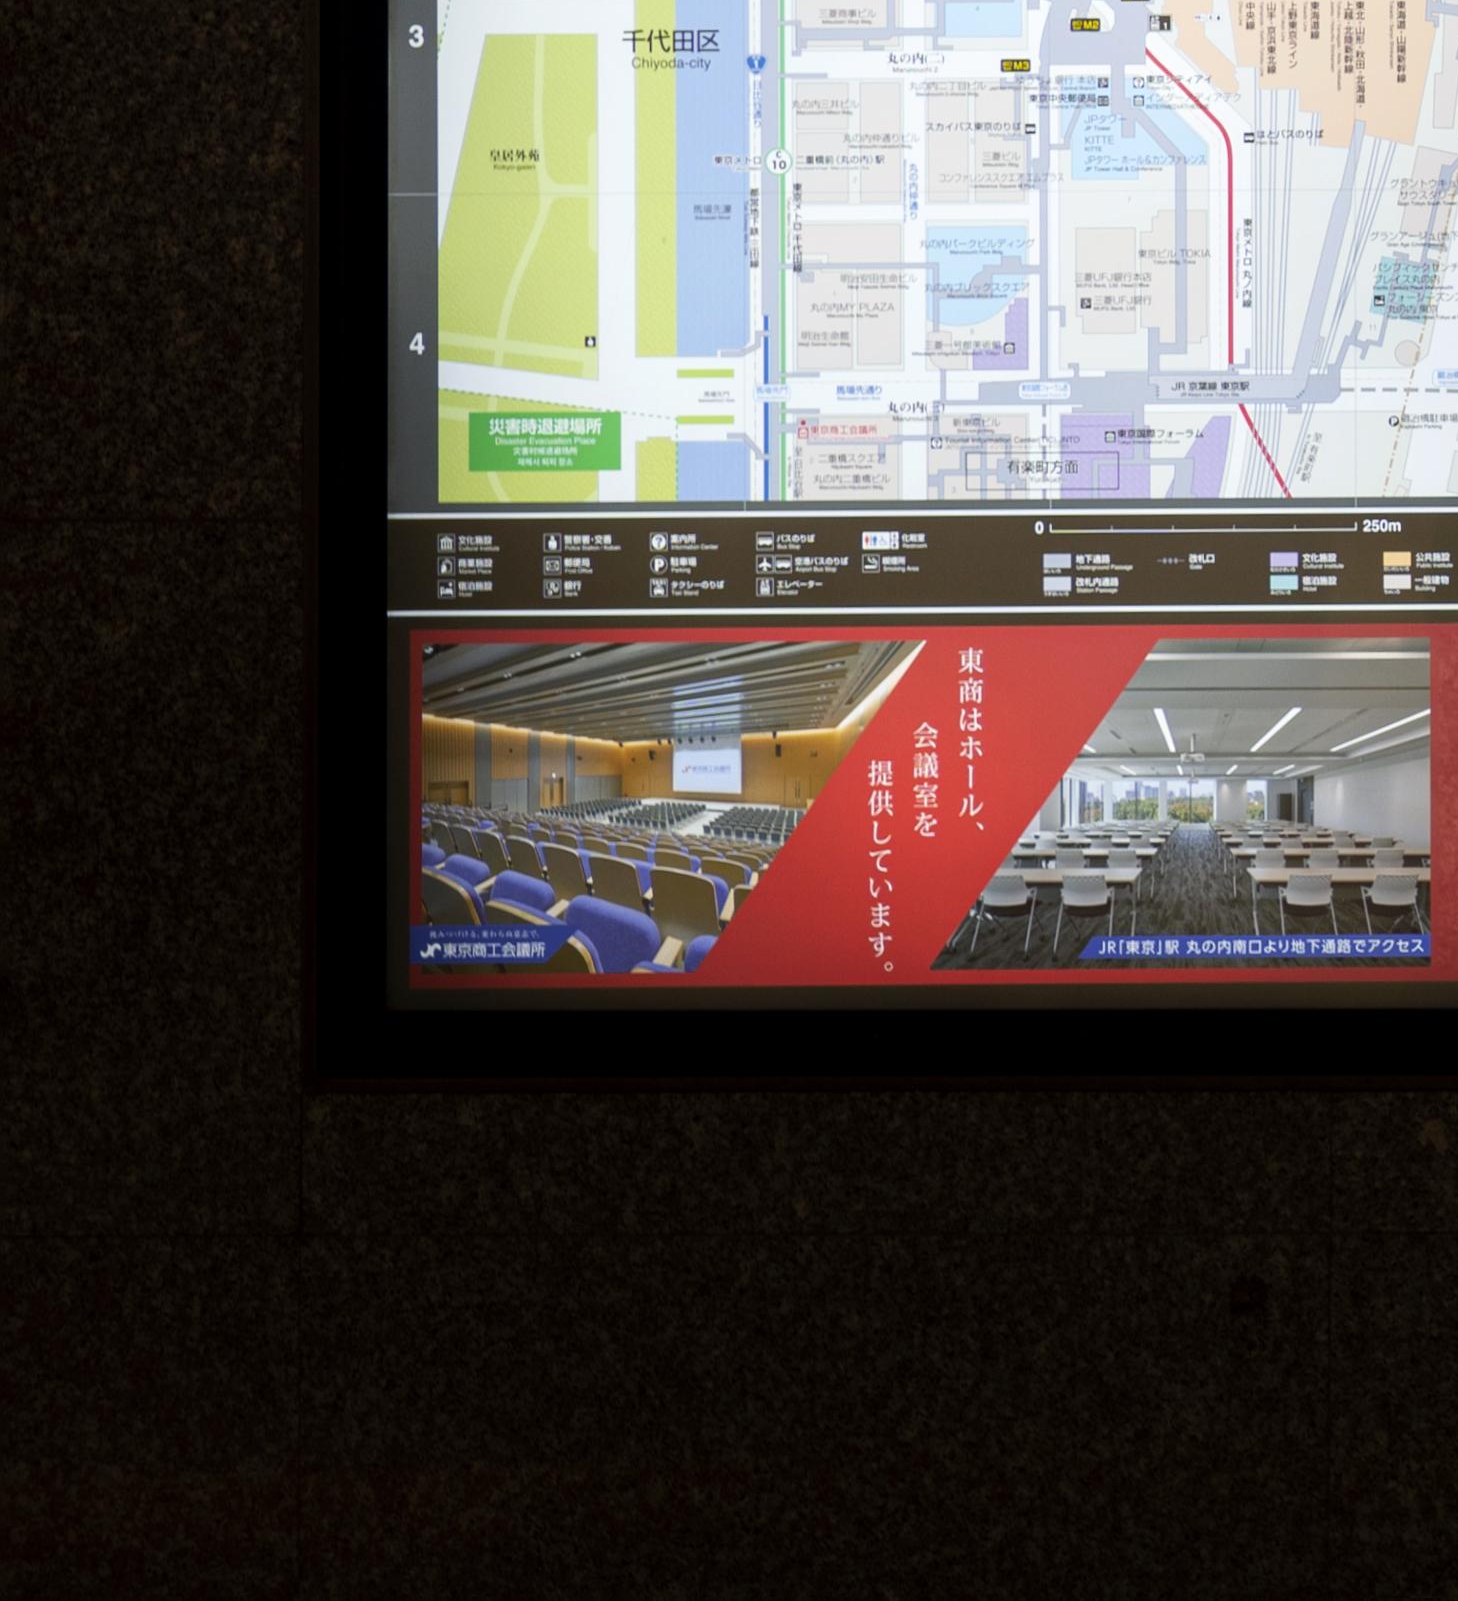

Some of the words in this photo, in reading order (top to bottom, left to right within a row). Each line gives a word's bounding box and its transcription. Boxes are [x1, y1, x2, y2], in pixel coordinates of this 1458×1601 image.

[408, 24, 425, 48] 3
[621, 28, 721, 55] 千代田区
[630, 56, 713, 71] Chiyoda-city
[409, 332, 426, 356] 4
[486, 416, 605, 437] 災害時退避場所
[1359, 518, 1402, 536] 250m
[958, 646, 984, 831] 東商はホール、
[913, 721, 939, 838] 会議室を
[867, 759, 894, 971] 提供しています。
[442, 939, 550, 961] 東京商工会議所
